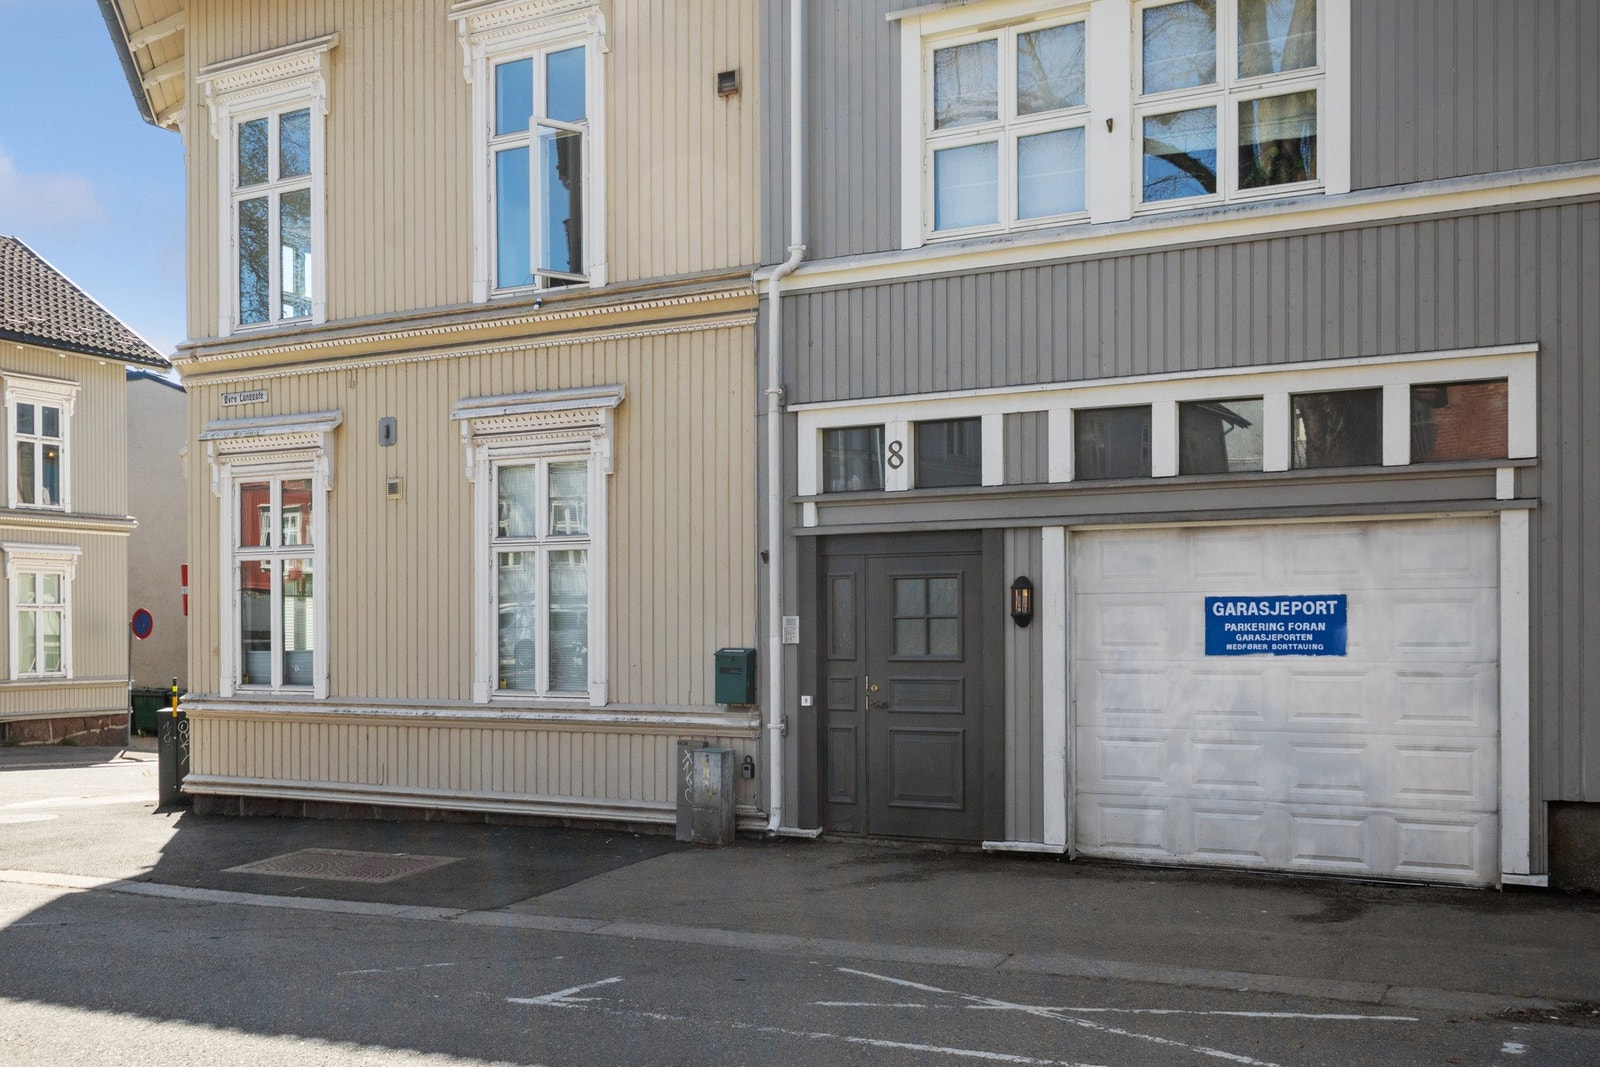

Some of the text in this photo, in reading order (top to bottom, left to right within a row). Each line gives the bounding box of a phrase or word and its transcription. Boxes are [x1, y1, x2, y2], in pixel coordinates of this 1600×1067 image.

[224, 392, 264, 404] Øvre Langgate
[887, 440, 904, 469] 8
[1212, 600, 1338, 616] GARASJEPORT
[1224, 622, 1326, 632] PARKERING FORAN
[1235, 633, 1313, 641] GARASJEPORTEN
